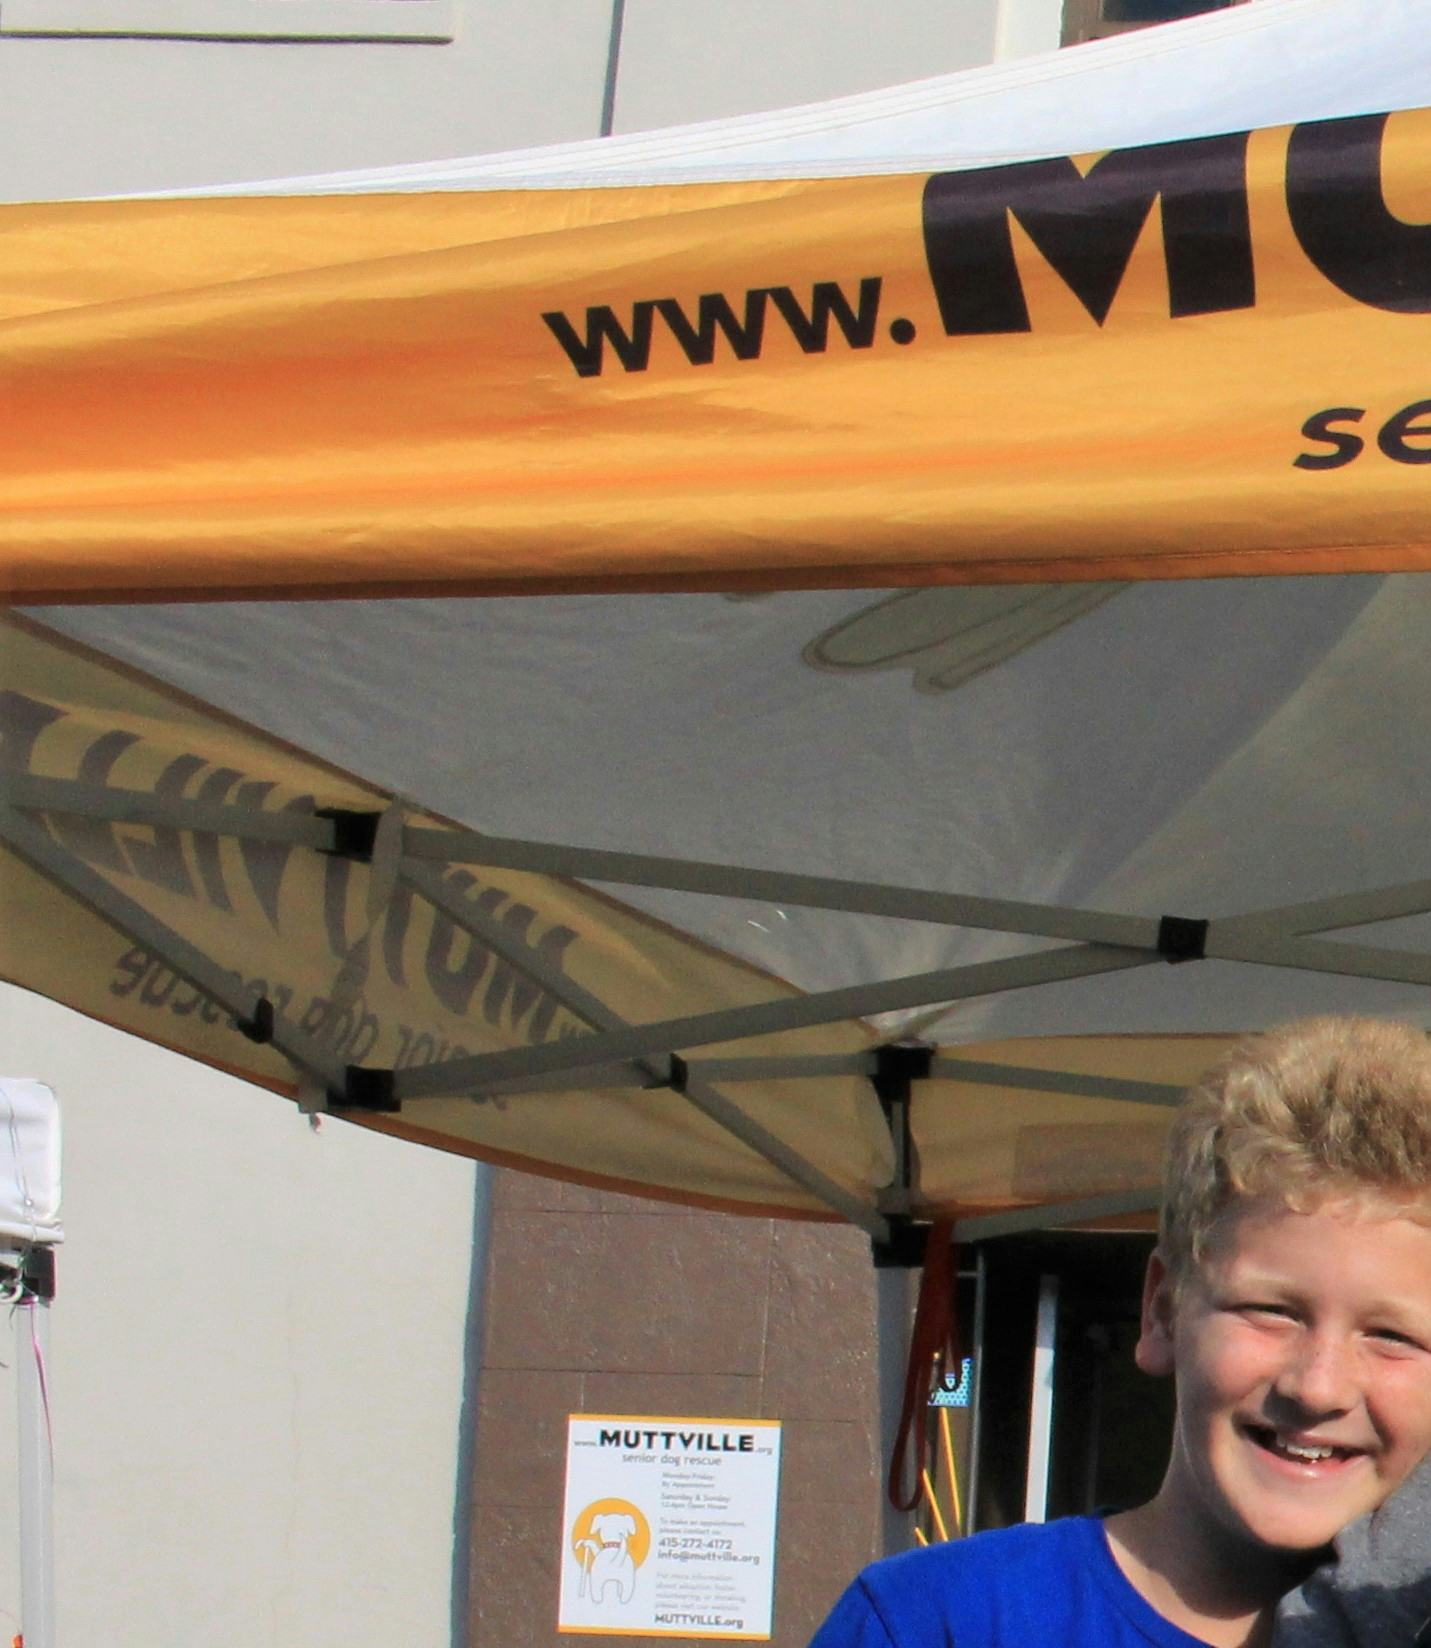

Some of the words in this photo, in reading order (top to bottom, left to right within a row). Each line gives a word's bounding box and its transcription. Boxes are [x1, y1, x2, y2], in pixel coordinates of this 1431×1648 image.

[622, 1452, 657, 1464] senior
[660, 1454, 681, 1467] dog
[684, 1456, 722, 1467] rescue
[655, 1613, 744, 1629] MUTTVILLE.org
